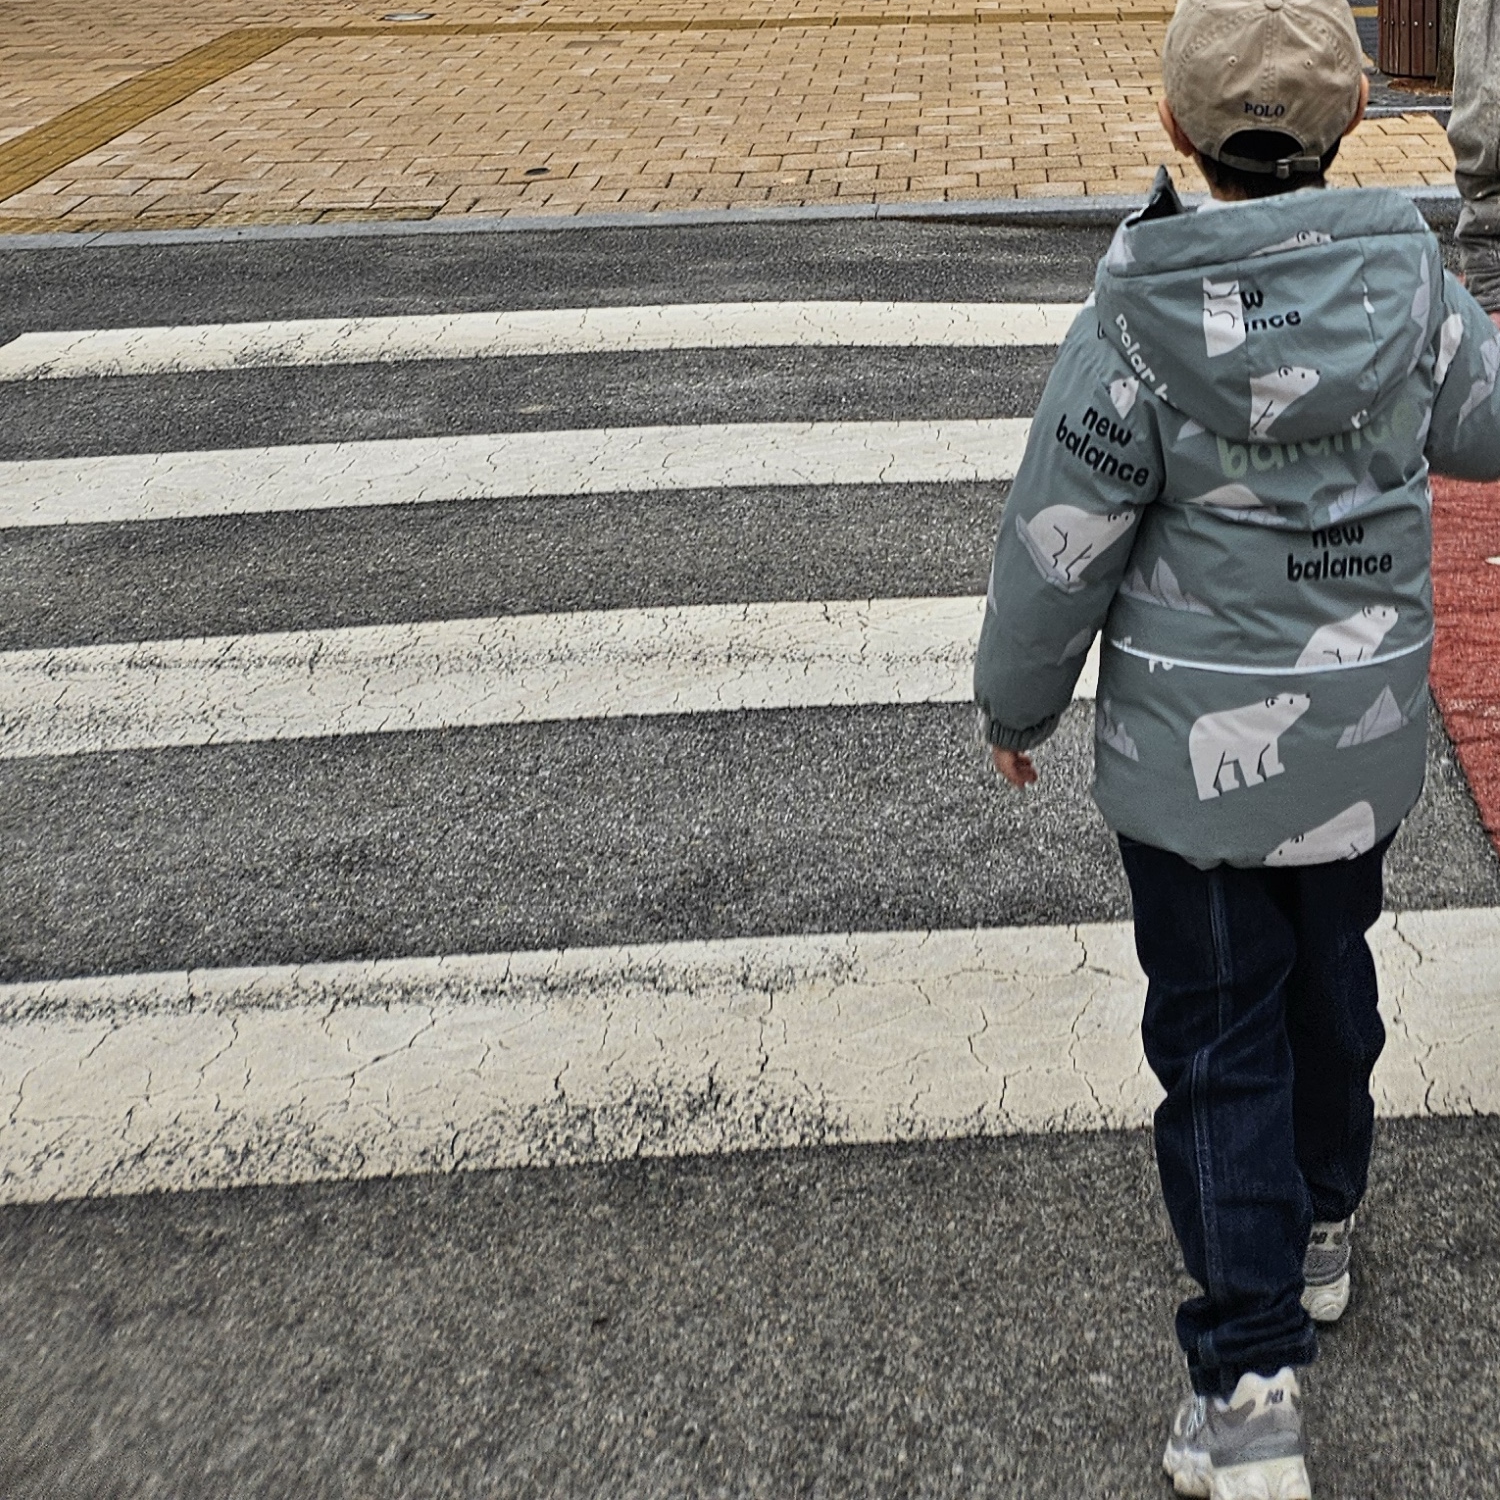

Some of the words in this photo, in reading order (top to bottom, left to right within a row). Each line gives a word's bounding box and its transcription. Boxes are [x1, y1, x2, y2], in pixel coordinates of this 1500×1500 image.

[1243, 101, 1285, 117] POLO
[1082, 406, 1132, 447] new
[1056, 413, 1150, 487] balance
[1311, 521, 1364, 548] new
[1287, 551, 1393, 582] balance
